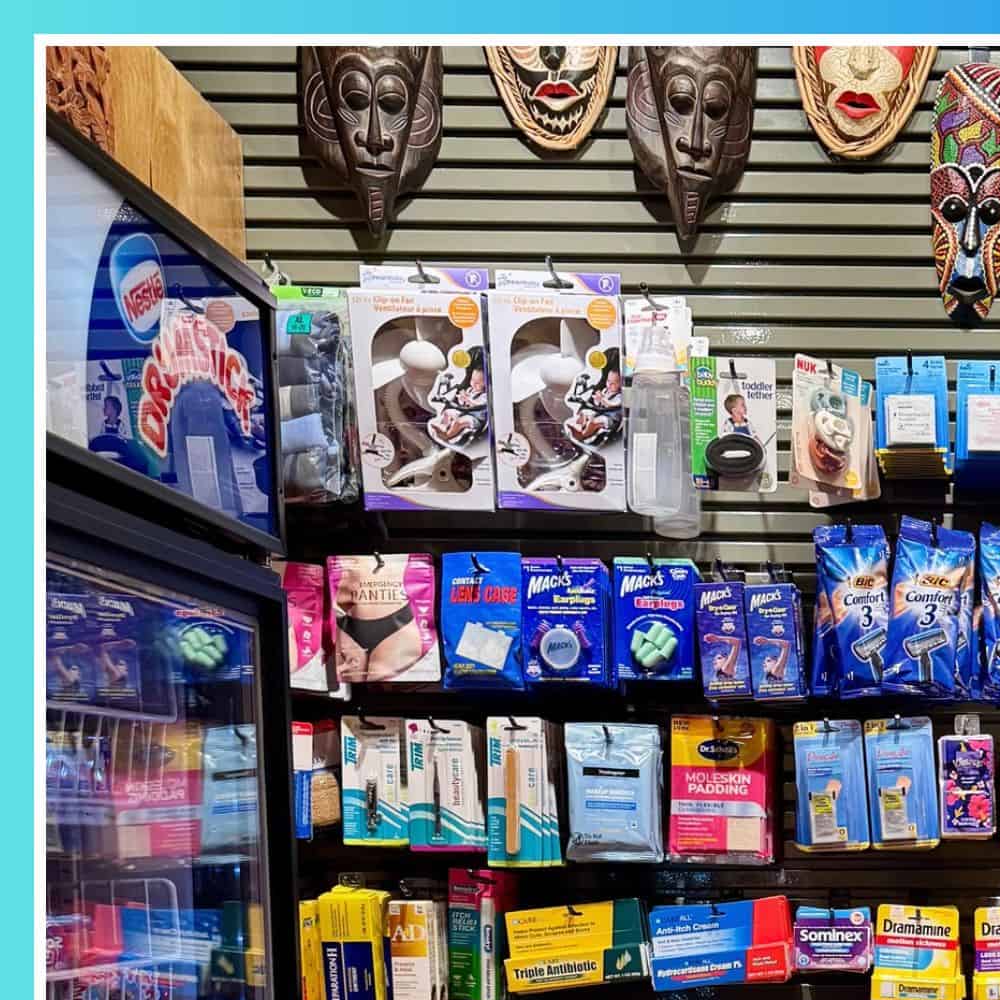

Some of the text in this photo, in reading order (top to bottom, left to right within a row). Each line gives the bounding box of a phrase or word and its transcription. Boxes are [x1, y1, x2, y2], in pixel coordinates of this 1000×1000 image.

[796, 358, 817, 373] NUK
[742, 381, 773, 393] toddler
[747, 389, 773, 401] tether
[352, 589, 409, 601] PANTIES
[843, 591, 885, 607] Comfort
[906, 590, 953, 605] Comfort
[861, 606, 873, 627] 3
[919, 604, 938, 626] 3
[344, 736, 358, 766] TRIM
[411, 742, 425, 771] TRIM
[490, 737, 502, 767] TRIM
[685, 772, 751, 785] MOLESKIN
[688, 784, 748, 796] PADDING
[656, 924, 691, 935] Anti-Itch
[883, 919, 951, 937] Dramamine
[800, 929, 863, 943] Sominex
[513, 961, 598, 979] Triple Antibiotic
